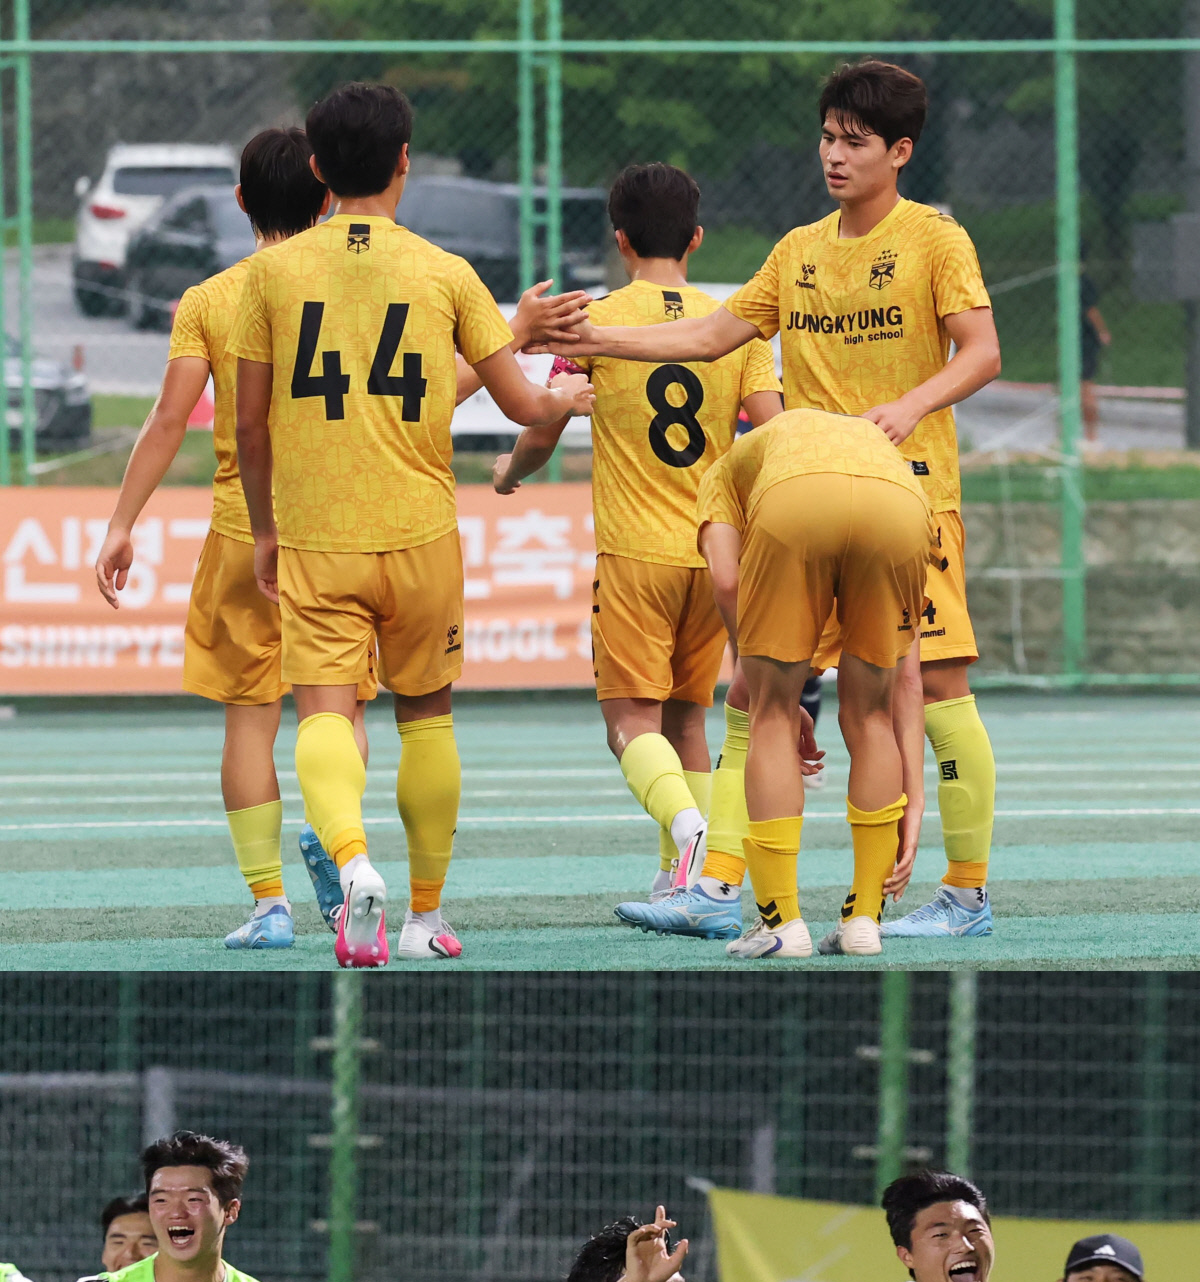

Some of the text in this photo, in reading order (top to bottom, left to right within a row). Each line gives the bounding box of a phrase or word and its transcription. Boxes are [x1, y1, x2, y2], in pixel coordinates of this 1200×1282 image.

[787, 305, 903, 334] JUNGKYUNG
[844, 328, 903, 345] high school
[291, 301, 427, 422] 44
[646, 364, 706, 468] 8
[1, 625, 186, 667] SHINPYE
